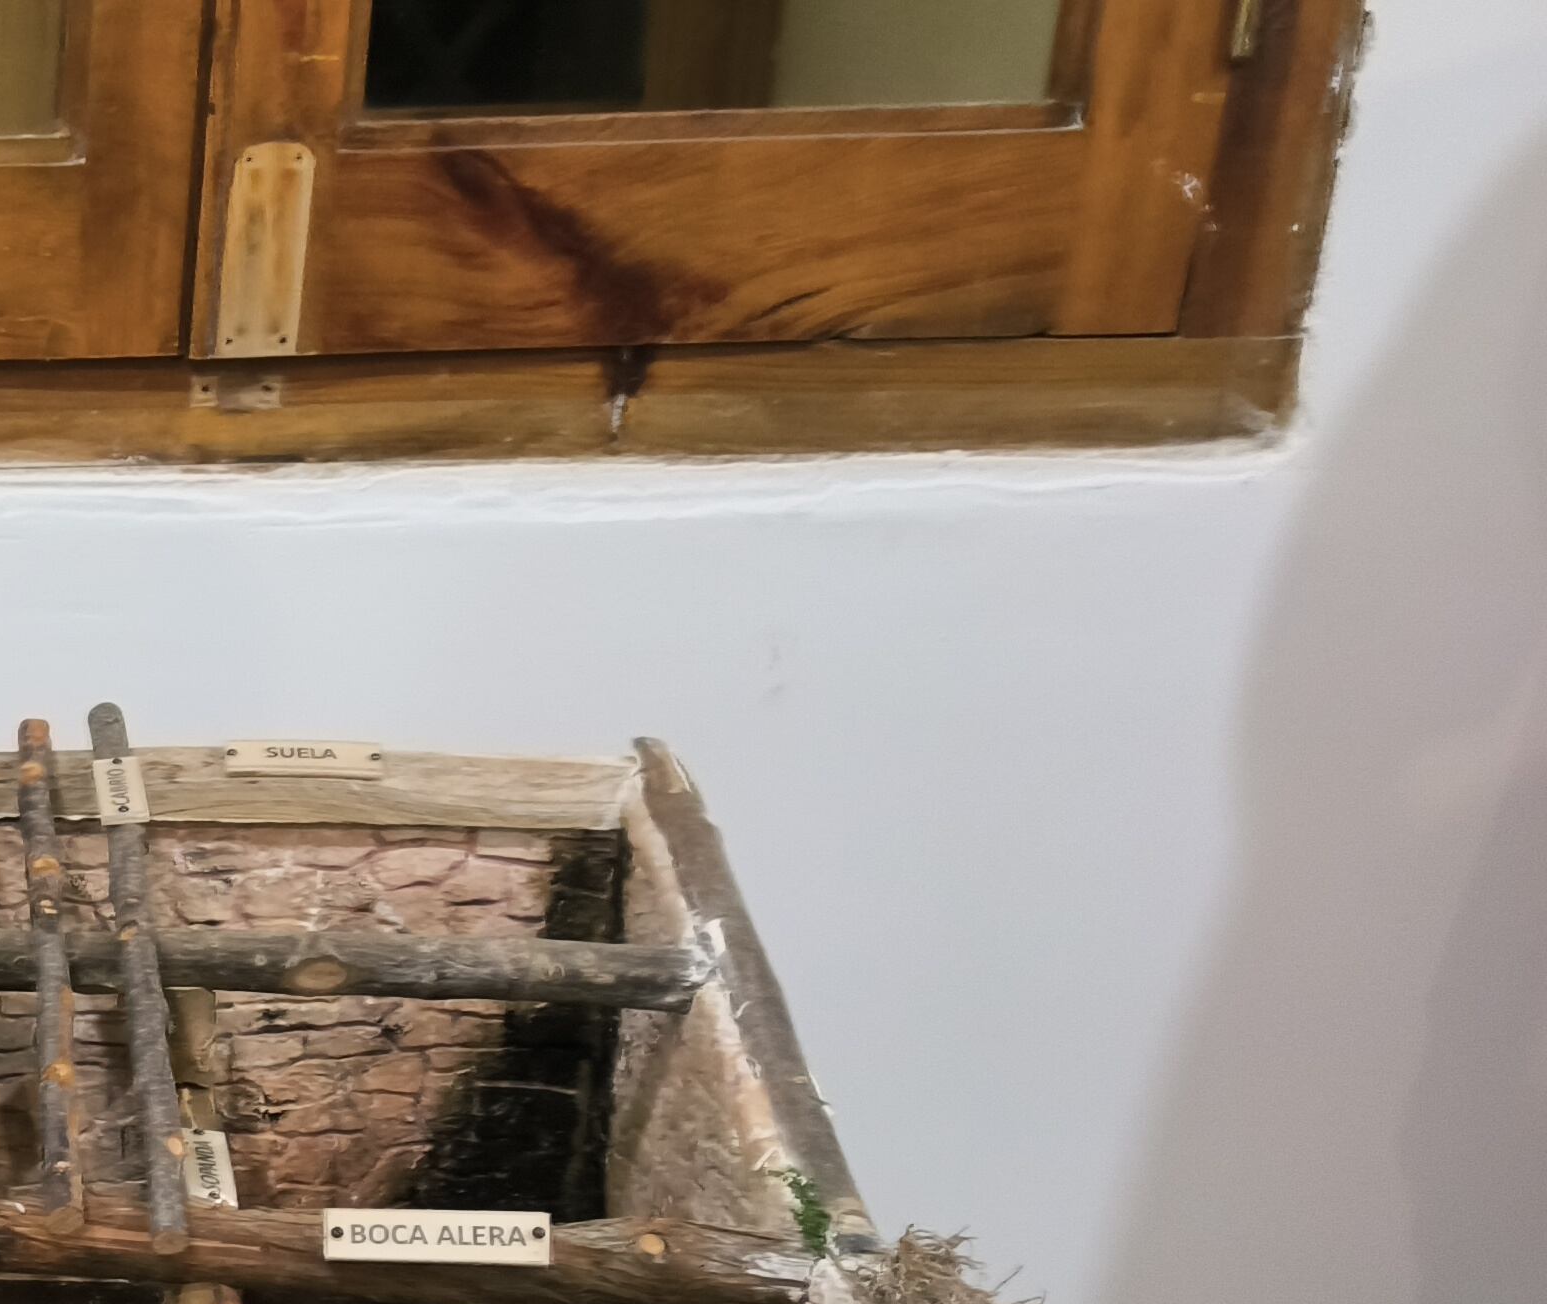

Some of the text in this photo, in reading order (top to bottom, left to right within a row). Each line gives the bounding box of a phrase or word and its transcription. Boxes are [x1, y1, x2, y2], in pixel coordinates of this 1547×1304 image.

[264, 746, 338, 760] SUELA
[193, 1140, 221, 1195] SOPANDA
[350, 1223, 527, 1247] BOCA ALERA
